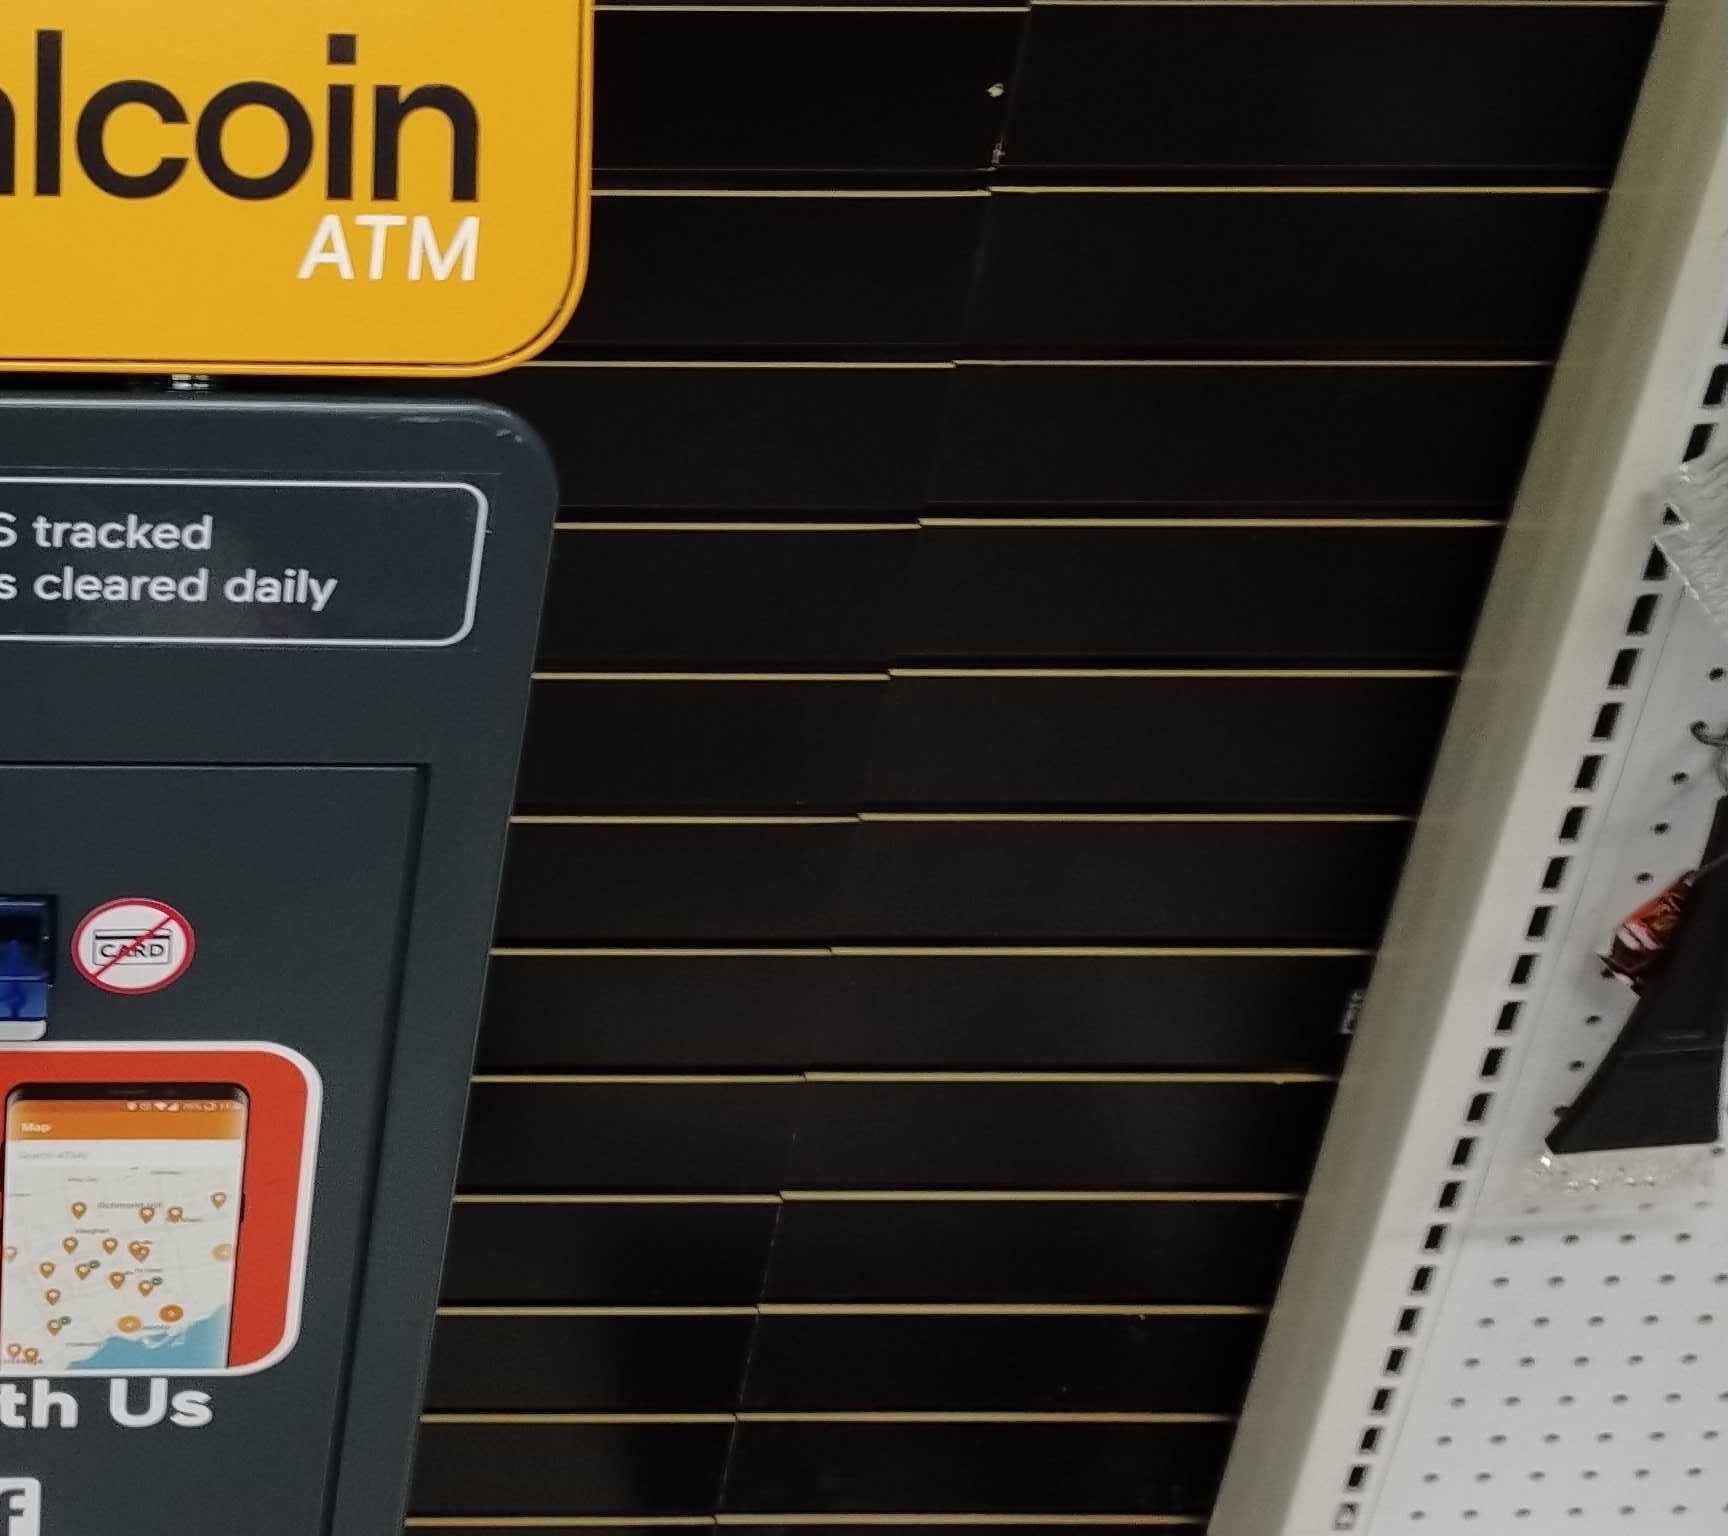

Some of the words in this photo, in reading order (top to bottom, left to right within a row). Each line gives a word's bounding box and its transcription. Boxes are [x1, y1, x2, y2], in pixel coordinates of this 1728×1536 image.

[298, 215, 479, 280] ATM
[32, 514, 212, 549] tracked
[34, 566, 208, 601] cleared
[224, 568, 337, 611] daily
[109, 1378, 213, 1429] Us
